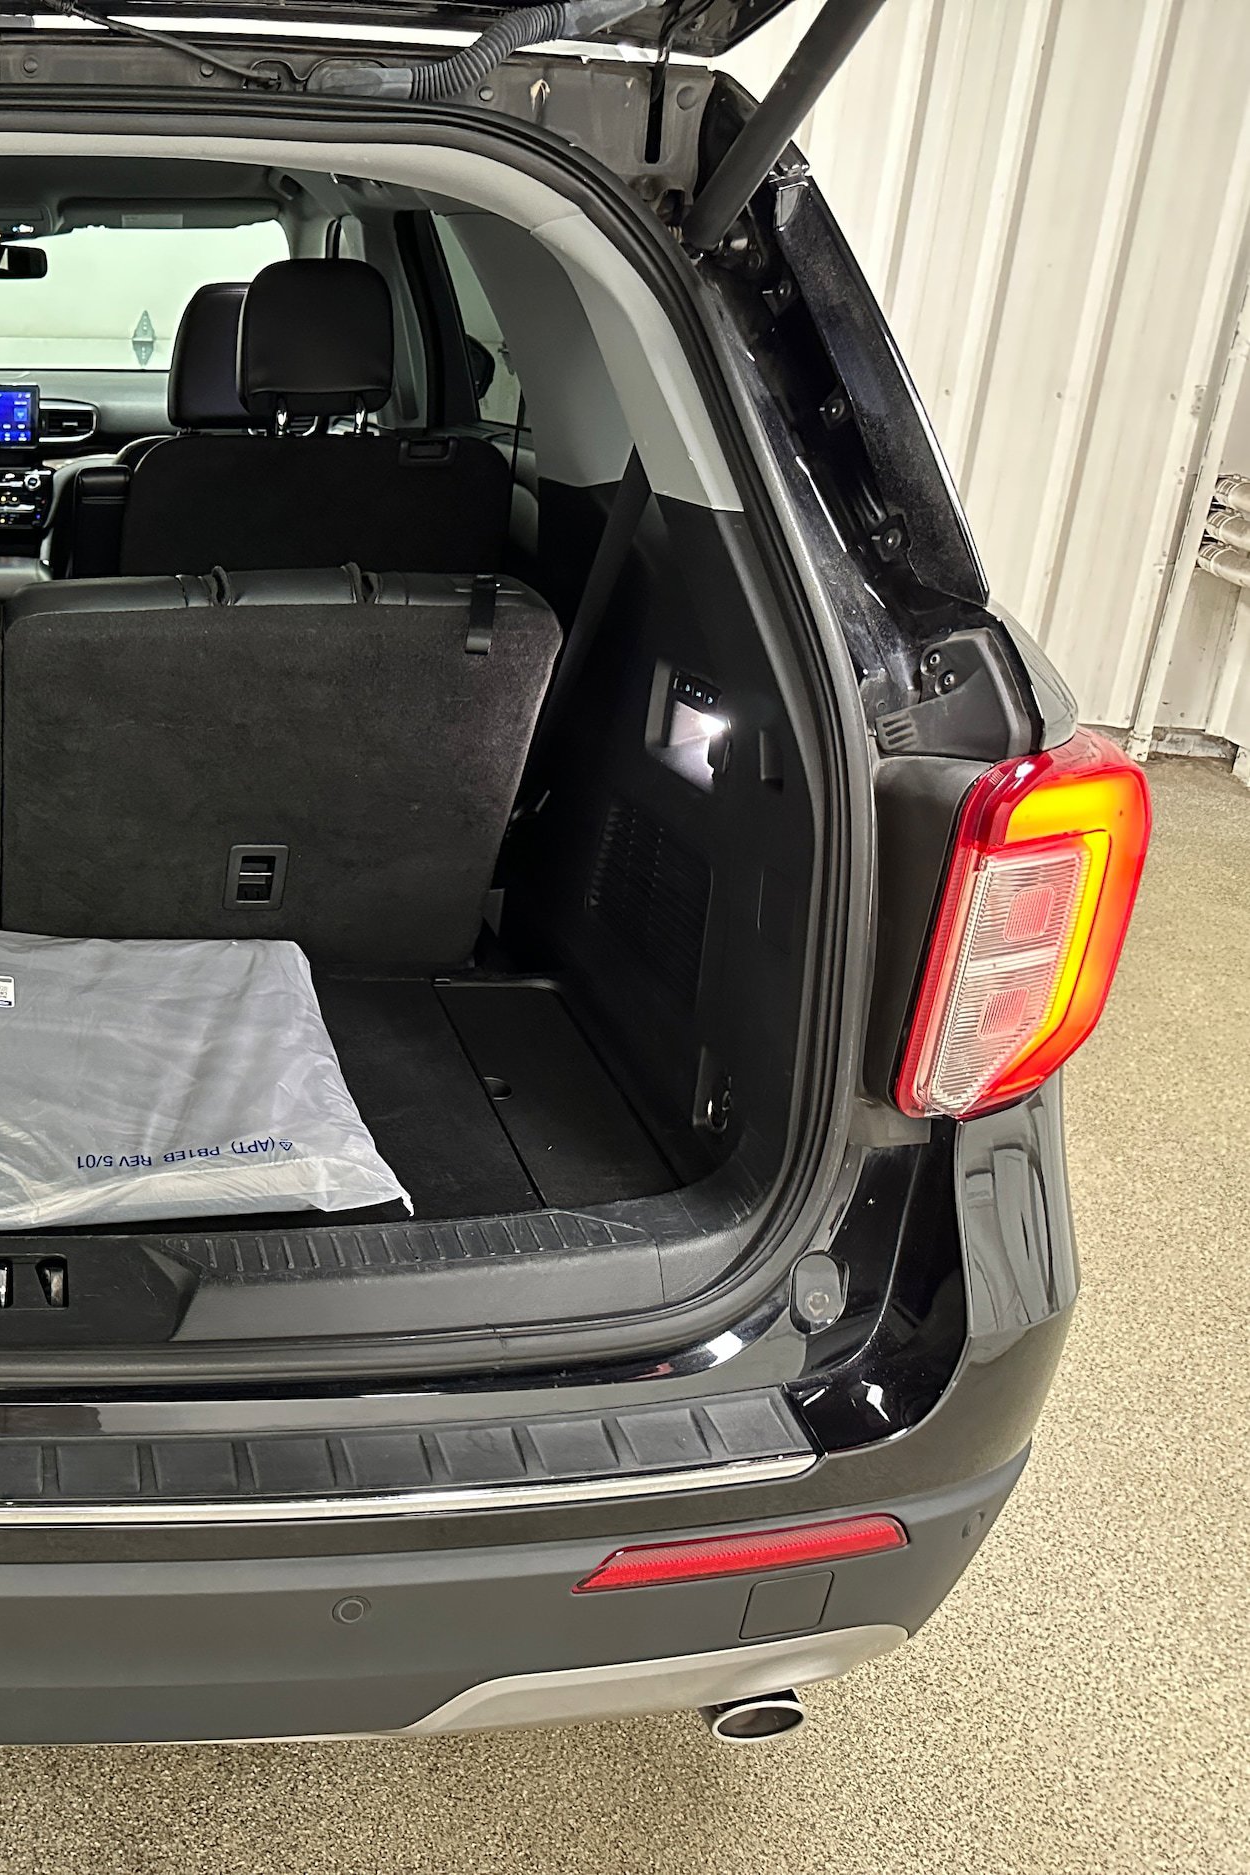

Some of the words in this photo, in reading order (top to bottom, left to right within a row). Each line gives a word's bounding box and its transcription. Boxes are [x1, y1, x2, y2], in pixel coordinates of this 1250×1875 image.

[231, 1136, 274, 1154] (APT)
[77, 1154, 113, 1169] 5/01
[119, 1154, 152, 1167] REV
[163, 1146, 220, 1163] PB1EB
